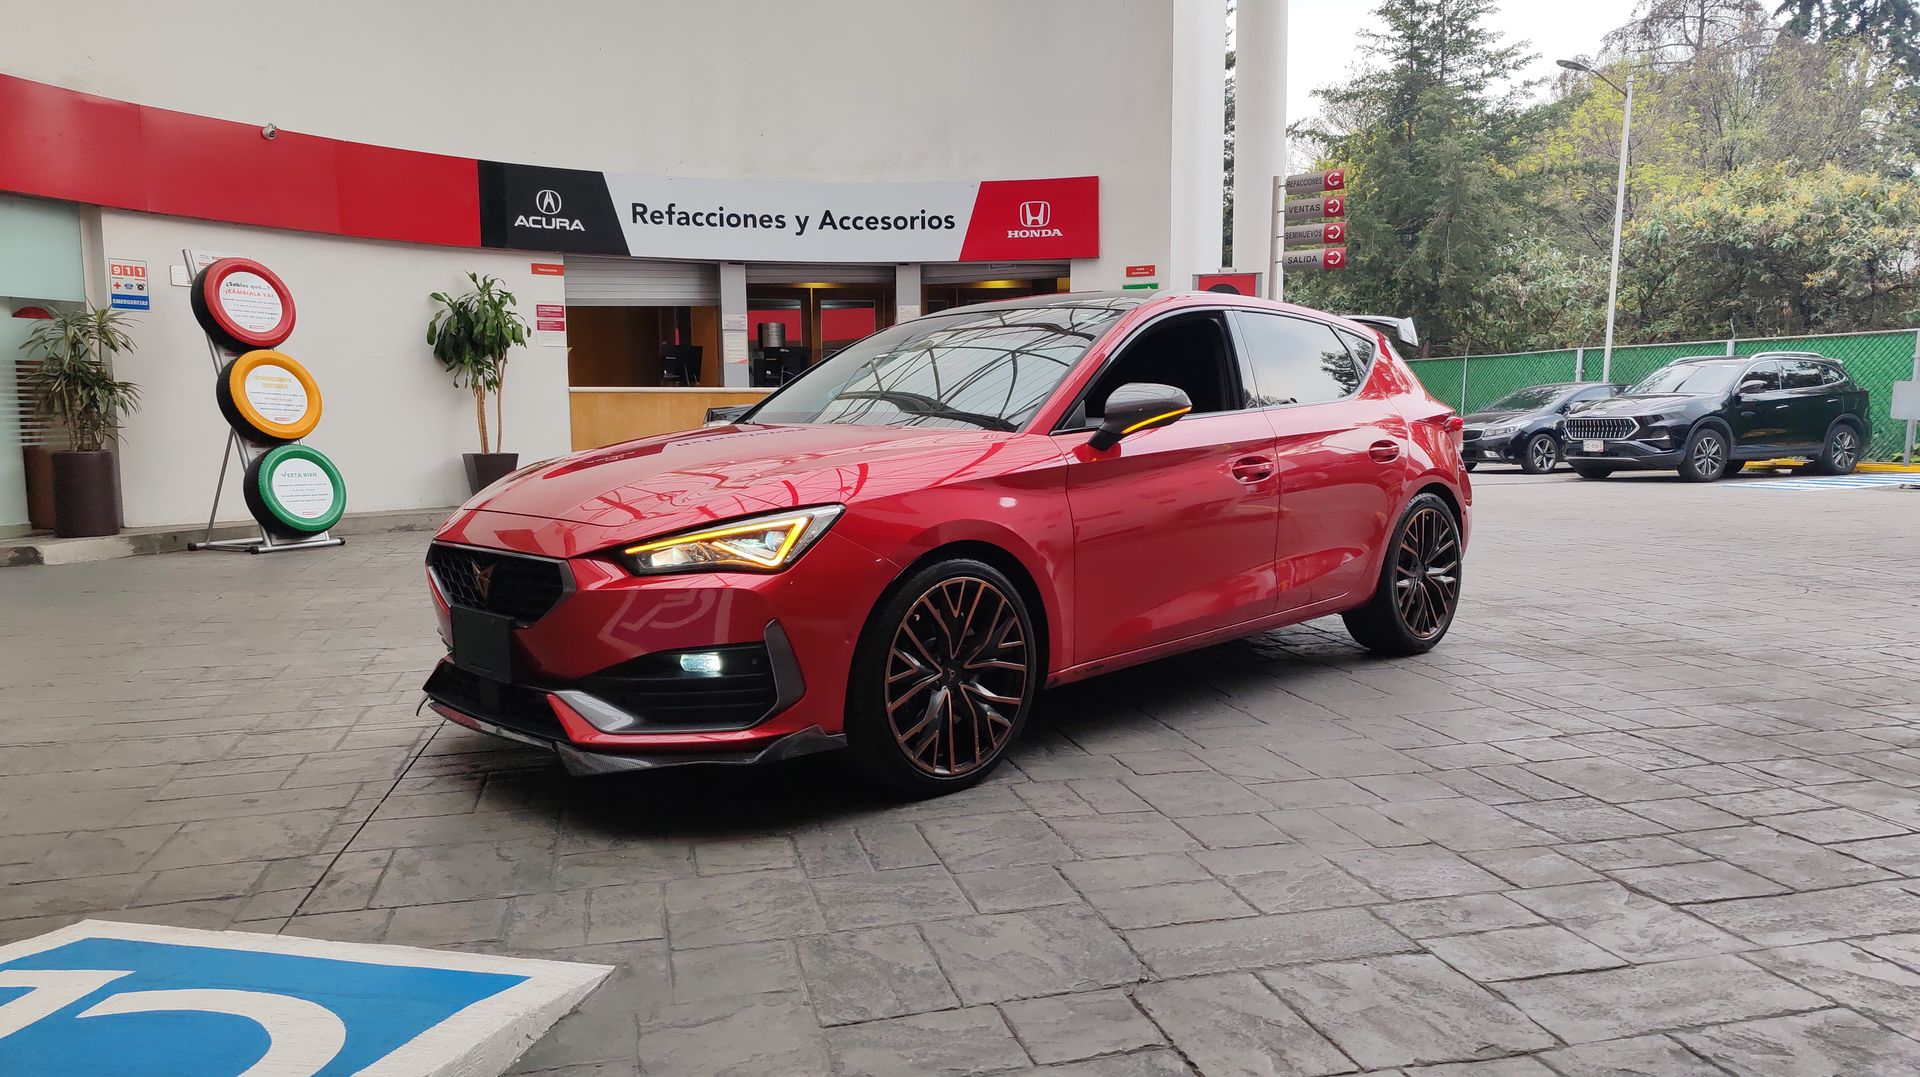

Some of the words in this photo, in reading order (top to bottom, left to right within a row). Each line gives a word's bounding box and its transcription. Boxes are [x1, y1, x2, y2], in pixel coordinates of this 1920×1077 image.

[1286, 177, 1323, 188] REFACCIONES
[1288, 204, 1321, 213] VENTAS
[513, 215, 586, 232] ACURA
[631, 202, 787, 229] Refacciones
[795, 214, 810, 236] y
[818, 209, 956, 231] Accesorios
[1007, 228, 1063, 238] HONDA
[1285, 229, 1323, 240] SEMINUEVOS
[1287, 255, 1318, 264] SALIDA
[113, 266, 143, 277] 911
[112, 298, 148, 306] EMERGENCIAS
